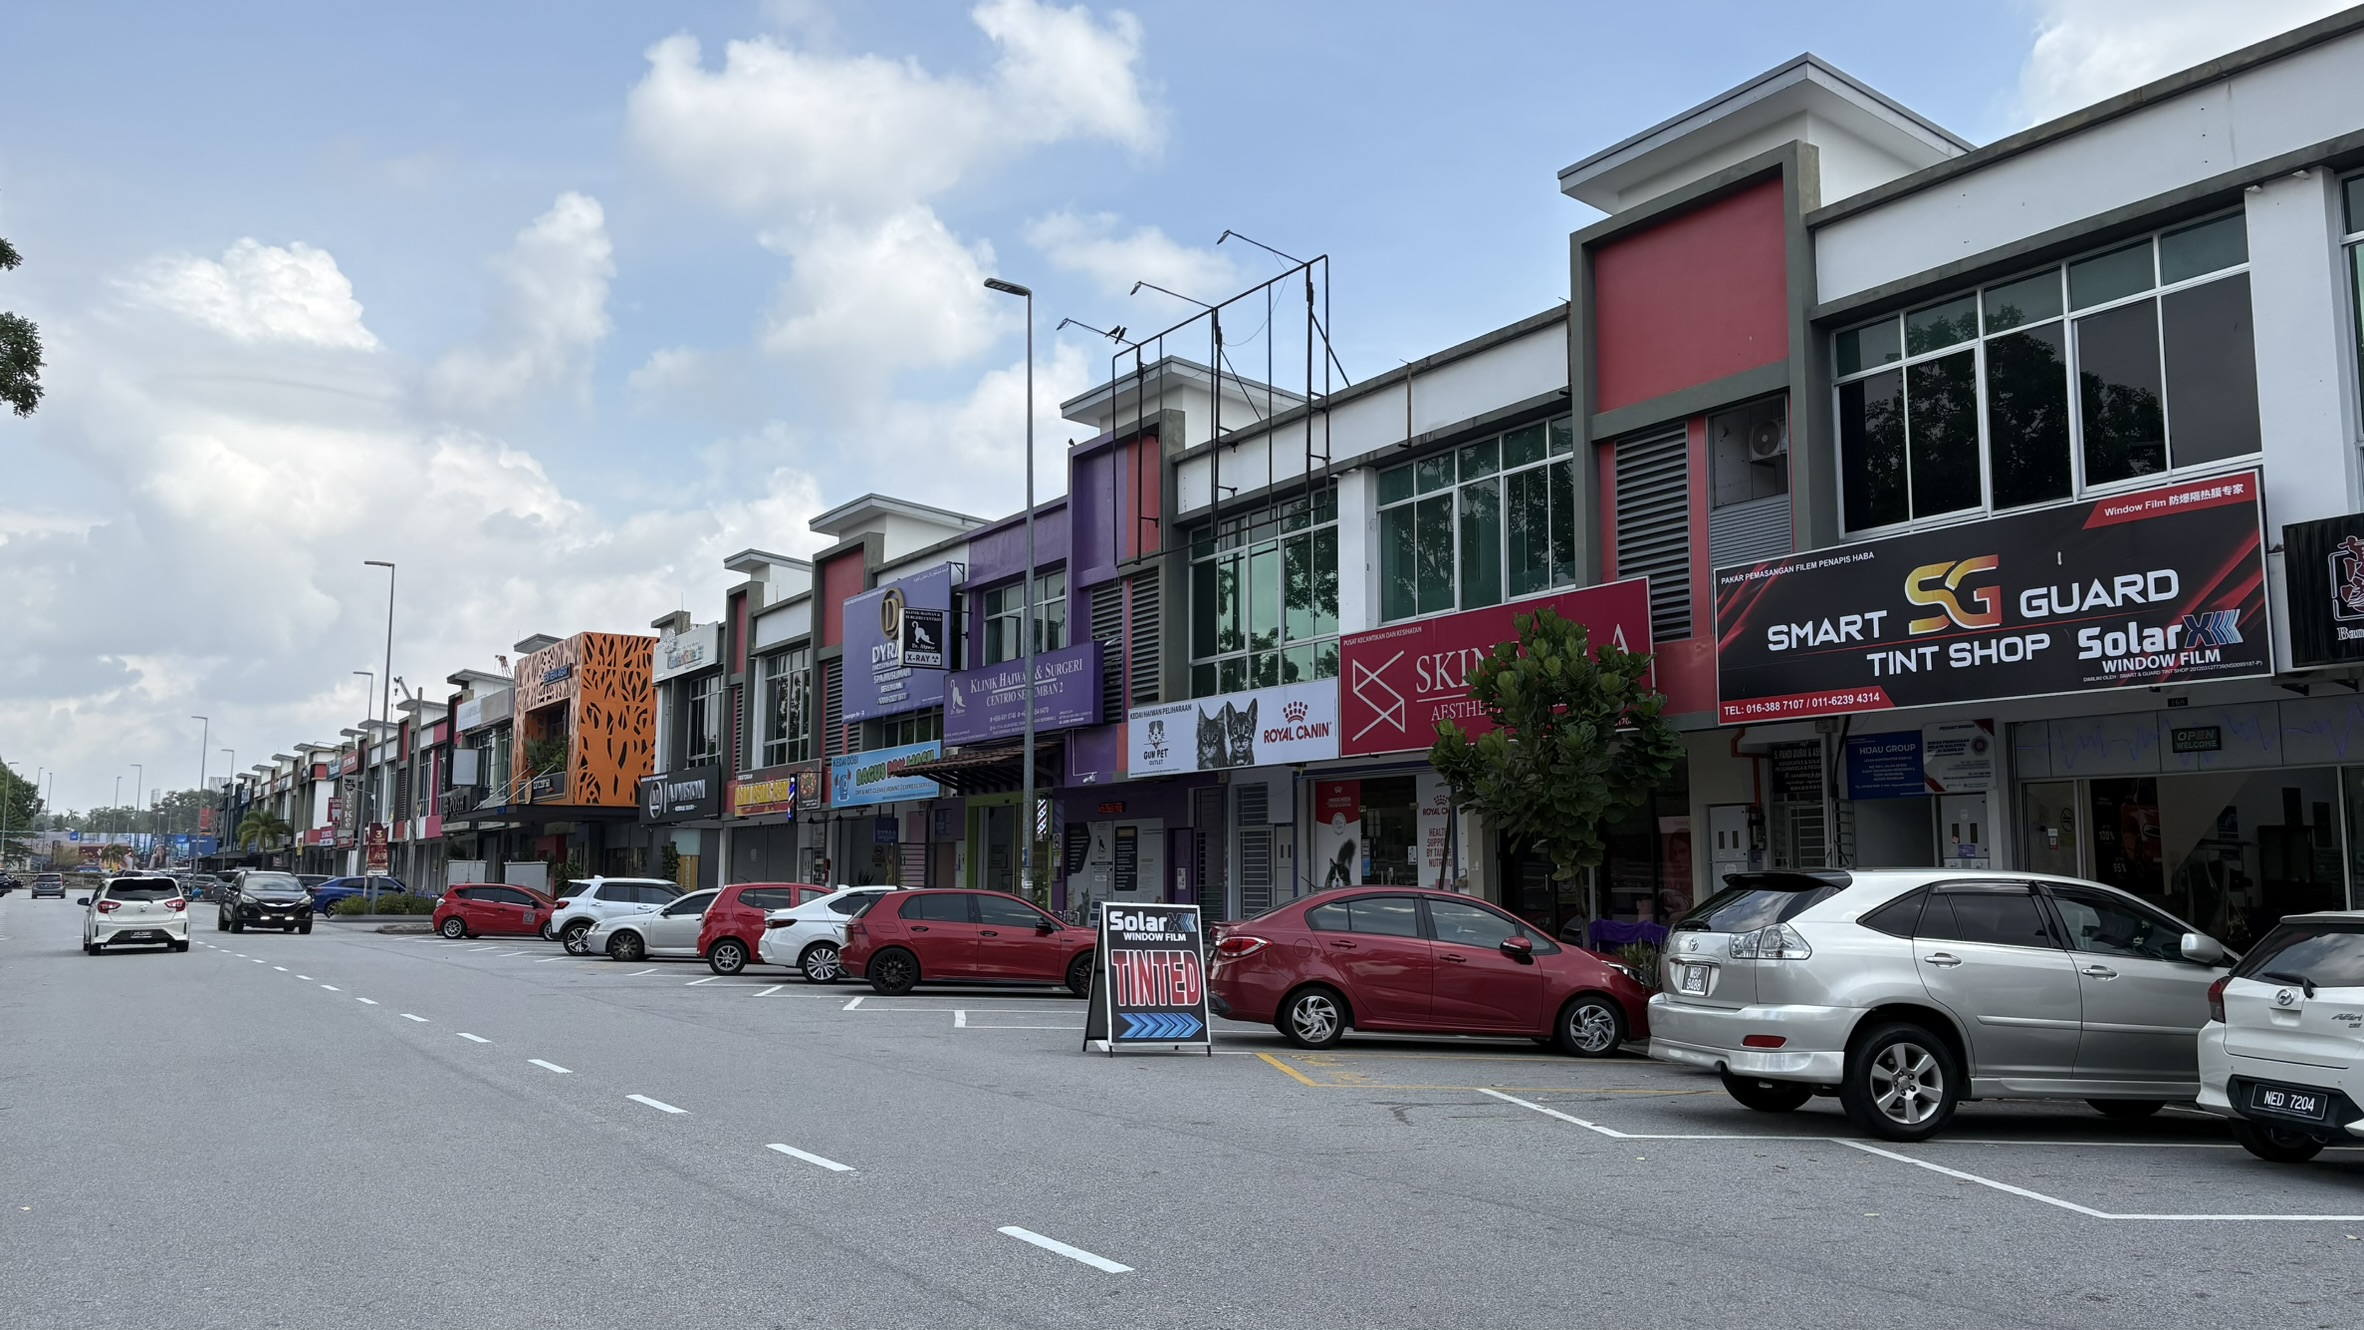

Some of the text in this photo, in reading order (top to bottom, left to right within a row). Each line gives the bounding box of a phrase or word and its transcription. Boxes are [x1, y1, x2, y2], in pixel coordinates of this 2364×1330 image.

[2104, 498, 2167, 517] Window Film
[1721, 551, 1875, 585] PAKAR PEMASANGAN FILEM PENAPIS HABA
[1767, 568, 2180, 651] SMART GUARD
[907, 653, 930, 663] X-RAY
[1866, 632, 2051, 677] TINT SHOP
[2101, 648, 2221, 674] WINDOW FILM
[999, 670, 1026, 688] HAIWA
[986, 691, 1017, 707] CENTRIO
[1059, 681, 1065, 693] 2
[1724, 705, 1745, 716] TEL:
[1746, 701, 1781, 714] 016-388
[1782, 699, 1804, 712] 7107
[1811, 694, 1854, 709] 011-6239
[1856, 691, 1880, 705] 4314
[1263, 721, 1330, 744] ROYAL CANIN
[2177, 729, 2215, 742] OPEN
[1157, 748, 1169, 759] PET
[1859, 743, 1916, 756] HIJAU GROUP
[2176, 739, 2217, 750] WELCOME
[856, 762, 886, 787] BAGUS
[1423, 808, 1440, 816] ROYAL
[1123, 932, 1187, 942] WINDOW FILM
[1111, 949, 1202, 1007] TINTED
[2264, 1090, 2285, 1107] NED
[2290, 1094, 2315, 1112] 7204
